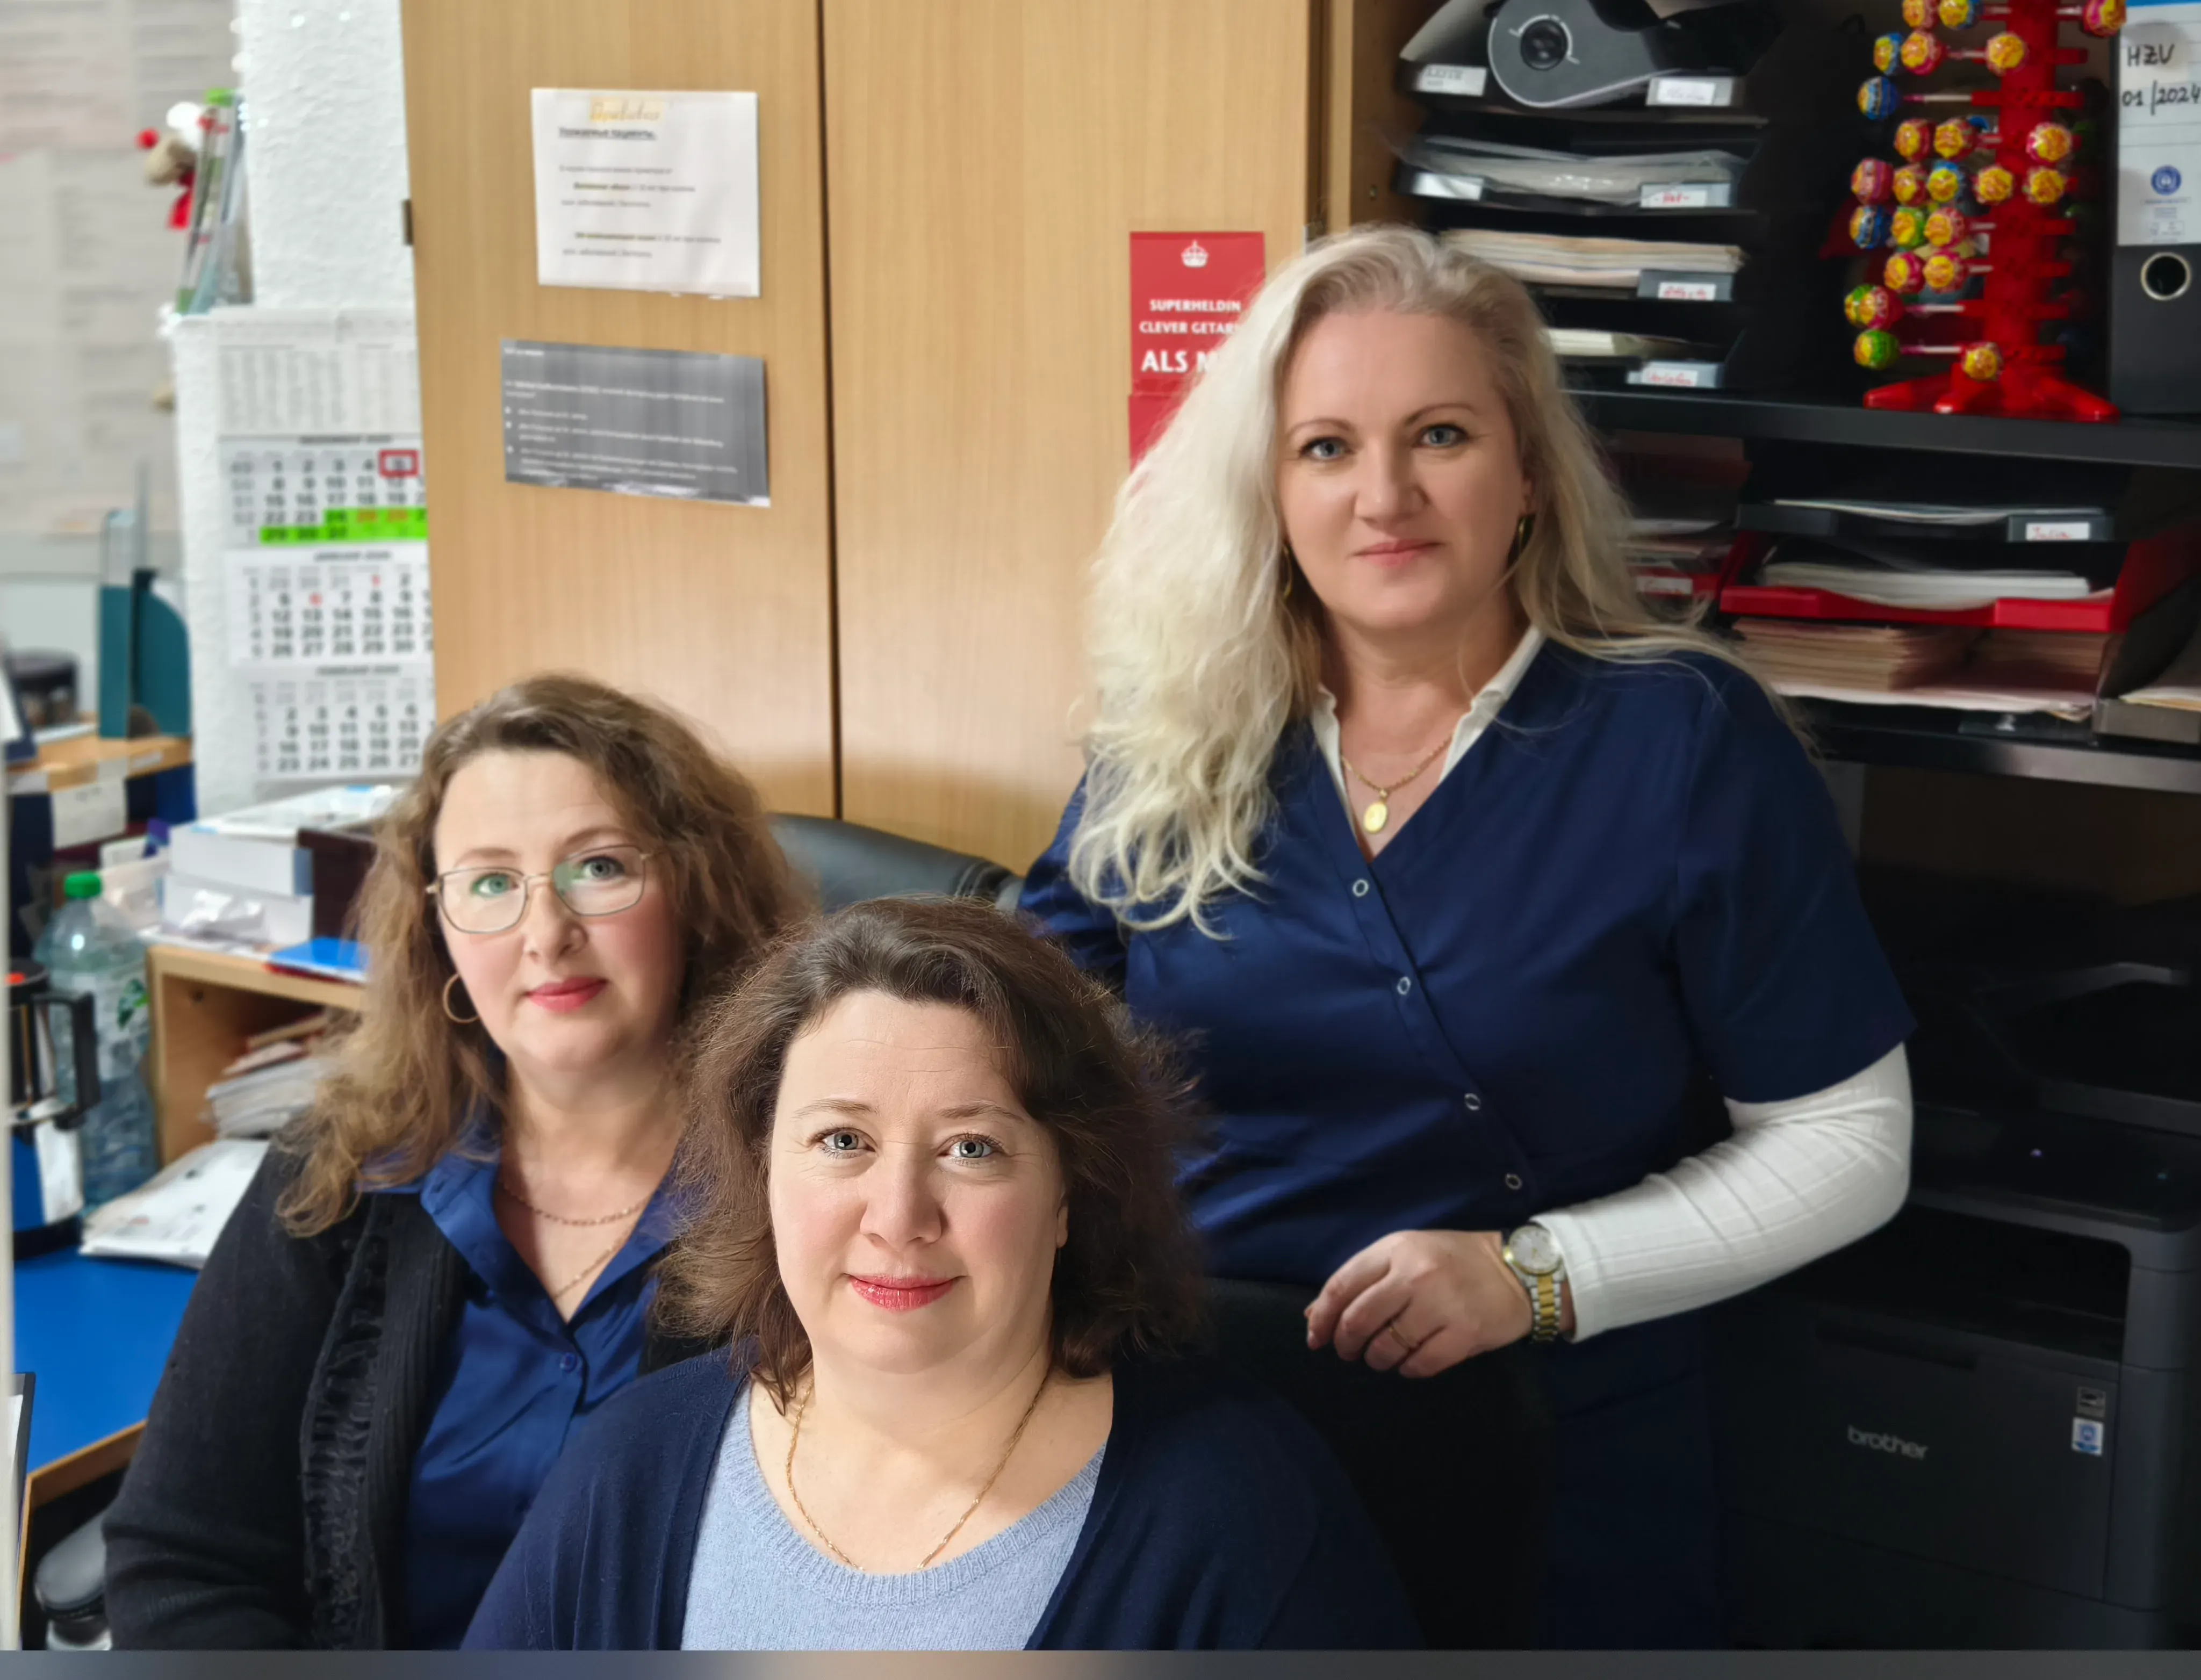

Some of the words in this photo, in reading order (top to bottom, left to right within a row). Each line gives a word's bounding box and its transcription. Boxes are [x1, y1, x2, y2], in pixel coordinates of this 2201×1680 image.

[2127, 43, 2175, 67] HZV
[1149, 299, 1241, 312] SUPERHELDIN
[1139, 321, 1188, 334] CLEVER
[1191, 321, 1235, 335] GETAR
[1141, 350, 1189, 373] ALS
[1847, 1424, 1928, 1460] brother
